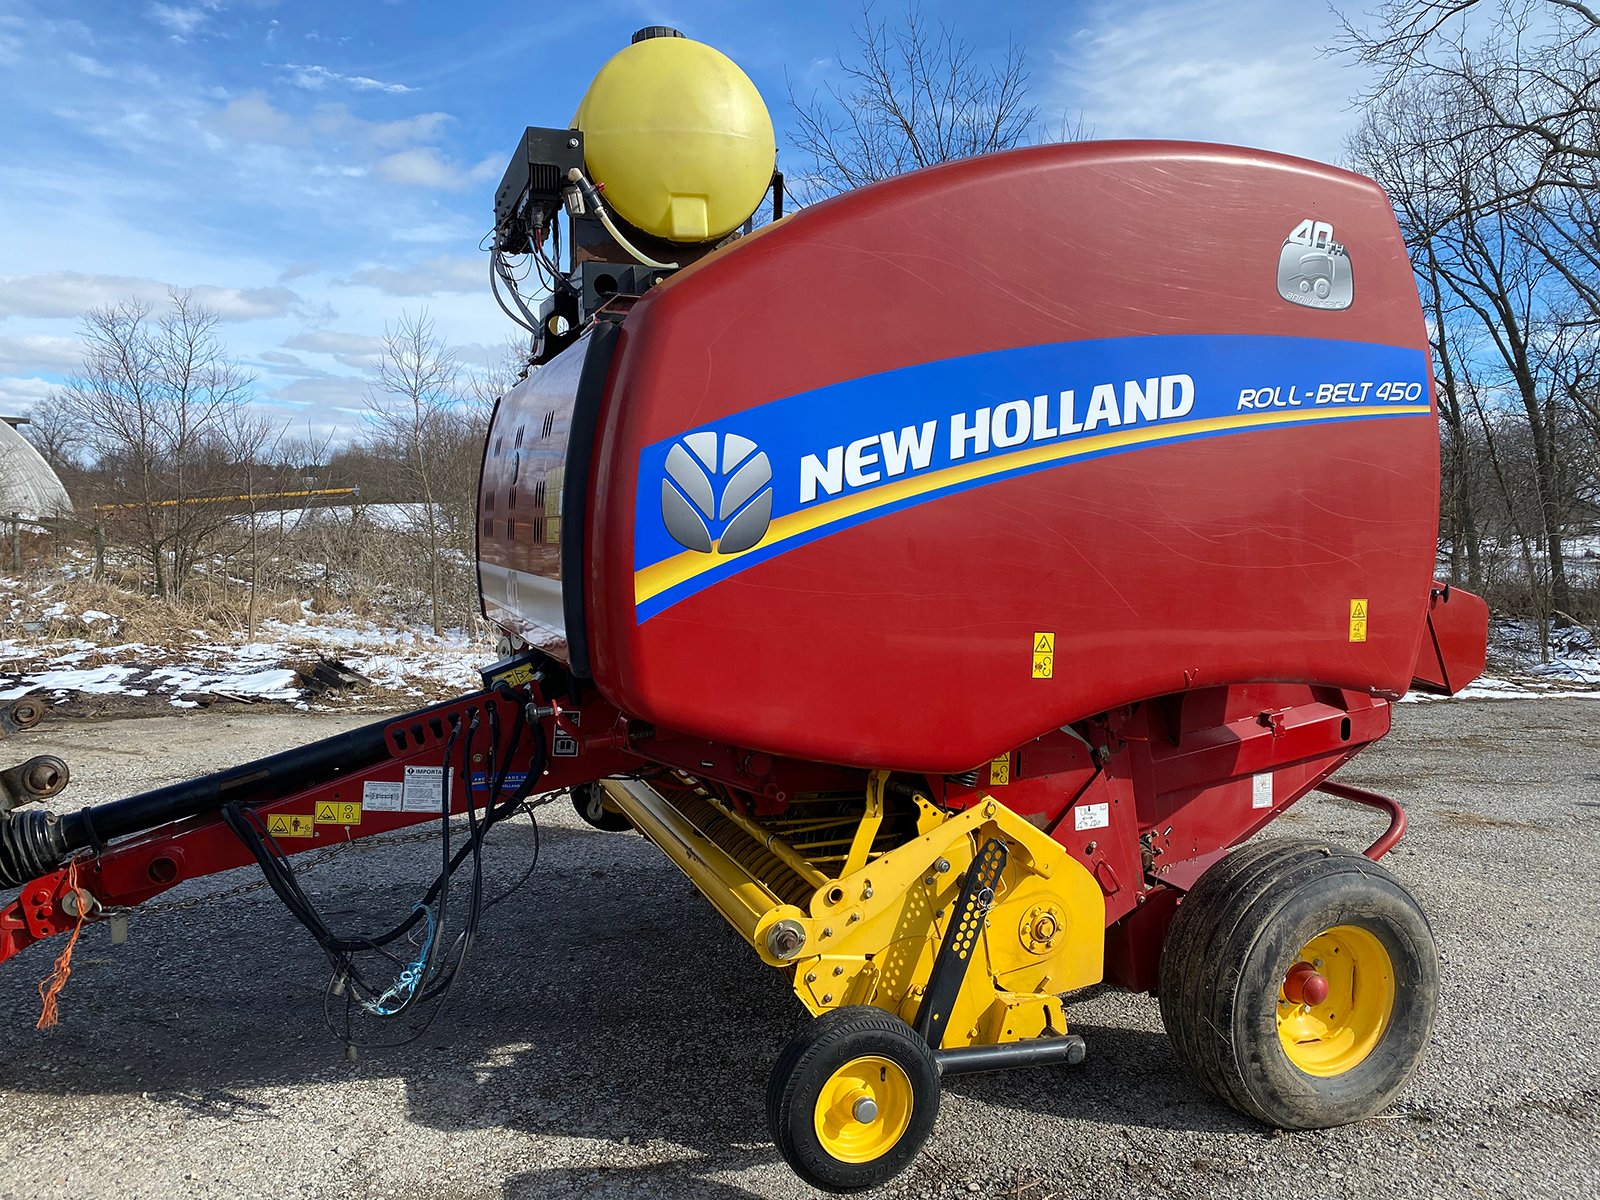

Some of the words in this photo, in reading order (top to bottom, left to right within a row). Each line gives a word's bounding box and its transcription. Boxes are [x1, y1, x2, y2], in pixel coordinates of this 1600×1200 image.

[1237, 381, 1374, 411] ROLL-BELT
[1374, 382, 1422, 403] 450
[799, 420, 937, 503] NEW
[949, 374, 1195, 461] HOLLAND
